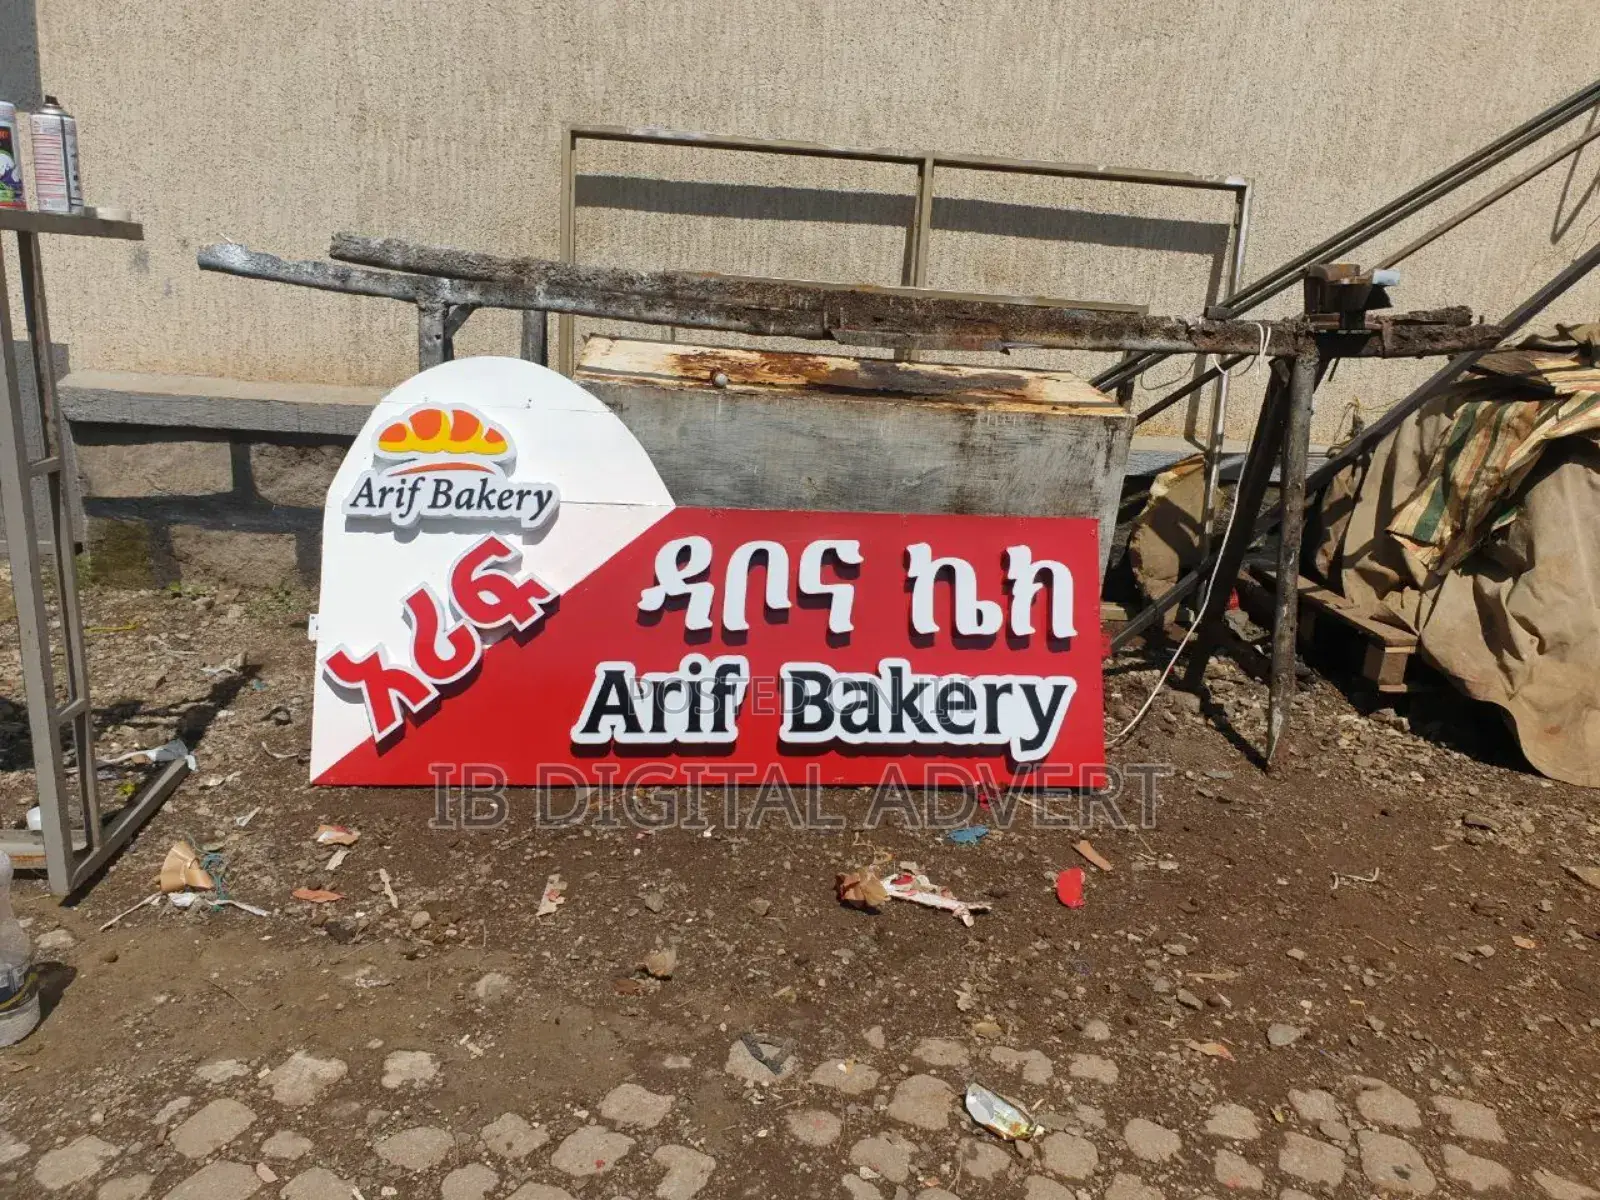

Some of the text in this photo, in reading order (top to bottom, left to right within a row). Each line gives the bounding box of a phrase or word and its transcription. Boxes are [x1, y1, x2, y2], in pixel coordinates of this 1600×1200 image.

[349, 476, 554, 521] Arif Bakery
[636, 534, 1079, 638] ዳቦና ኬክ
[322, 533, 559, 739] አሪፍ
[578, 661, 1070, 753] Arif Bakery
